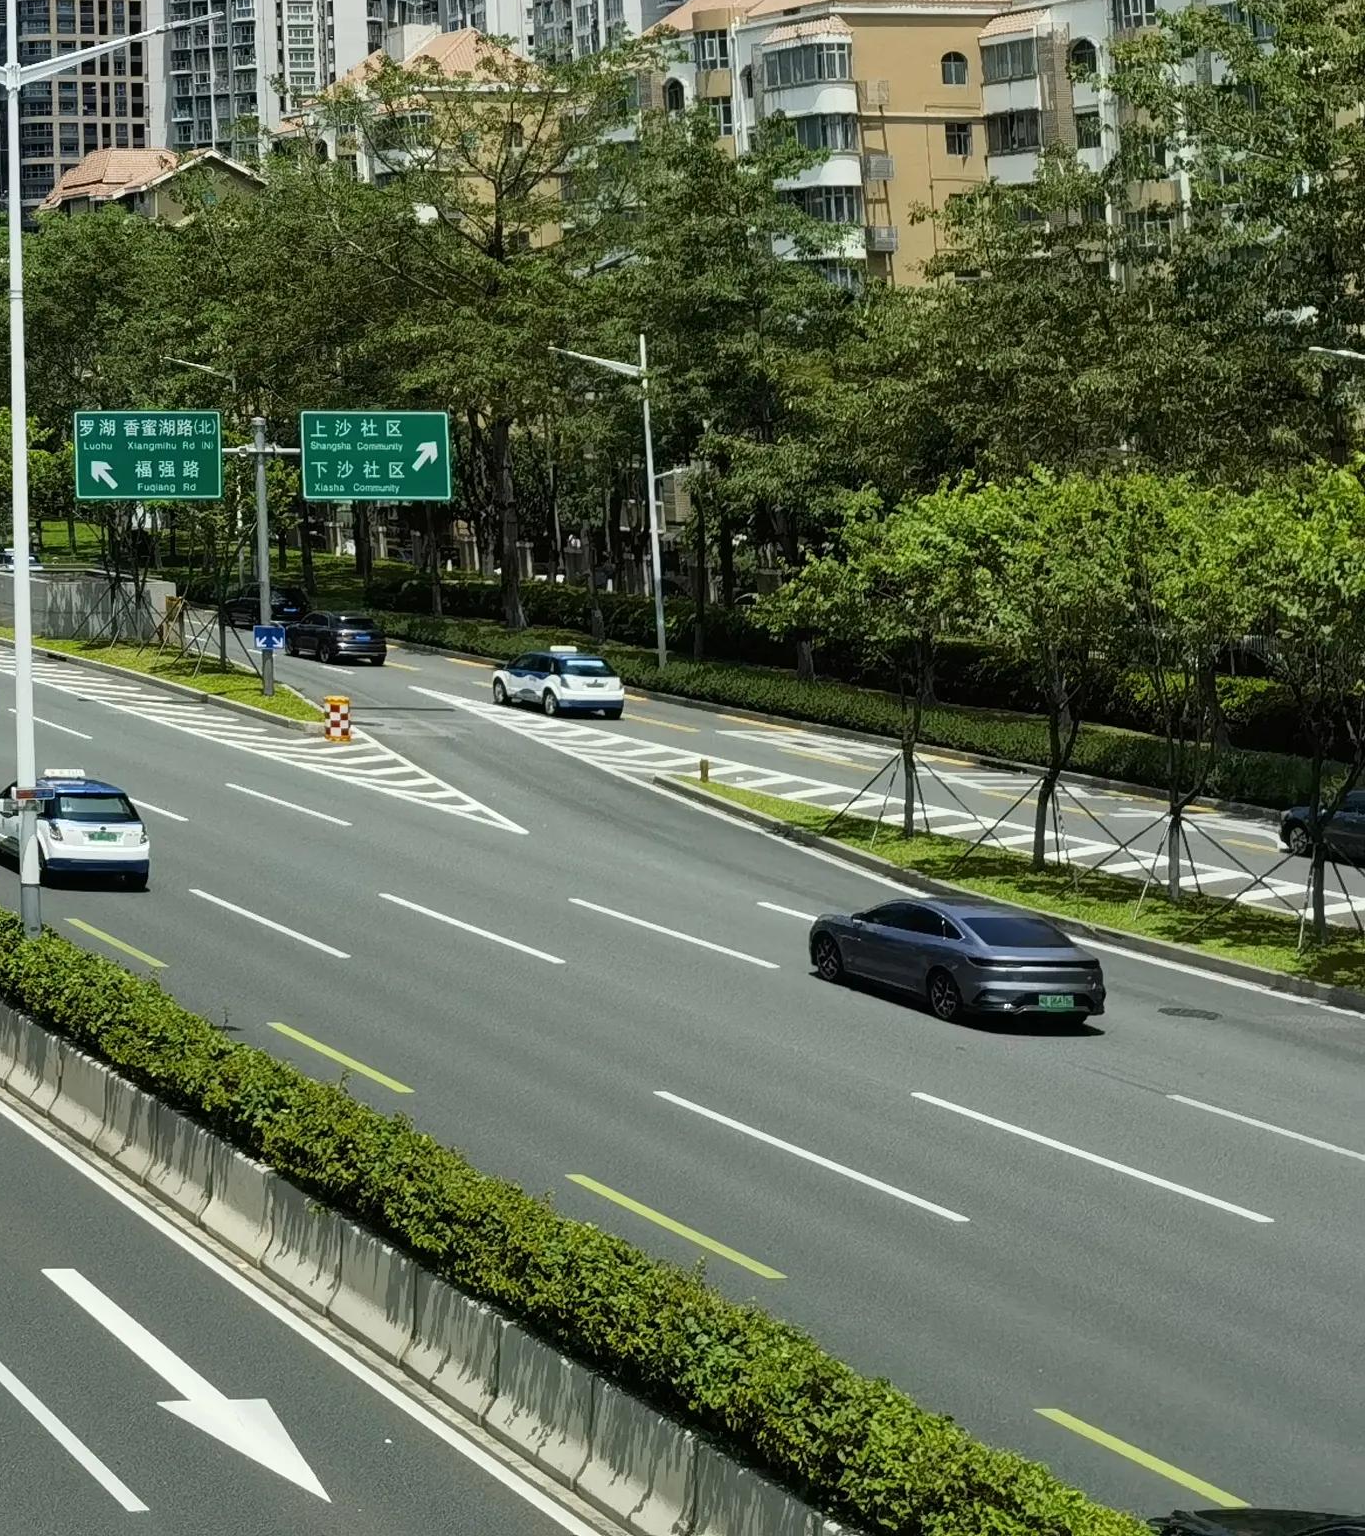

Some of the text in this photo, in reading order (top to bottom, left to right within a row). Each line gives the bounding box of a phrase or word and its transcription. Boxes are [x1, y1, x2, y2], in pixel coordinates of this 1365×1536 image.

[79, 418, 116, 437] 罗湖
[310, 418, 403, 437] 上沙社区
[83, 441, 113, 451] Luohu
[127, 441, 177, 451] Xiangmihu
[182, 441, 196, 450] Rd
[310, 441, 403, 452] Shangsha Community
[134, 460, 200, 479] 福强路
[311, 460, 405, 479] 下沙社区
[137, 482, 196, 493] Fuqiang Rd
[314, 483, 400, 494] Xiasha Community
